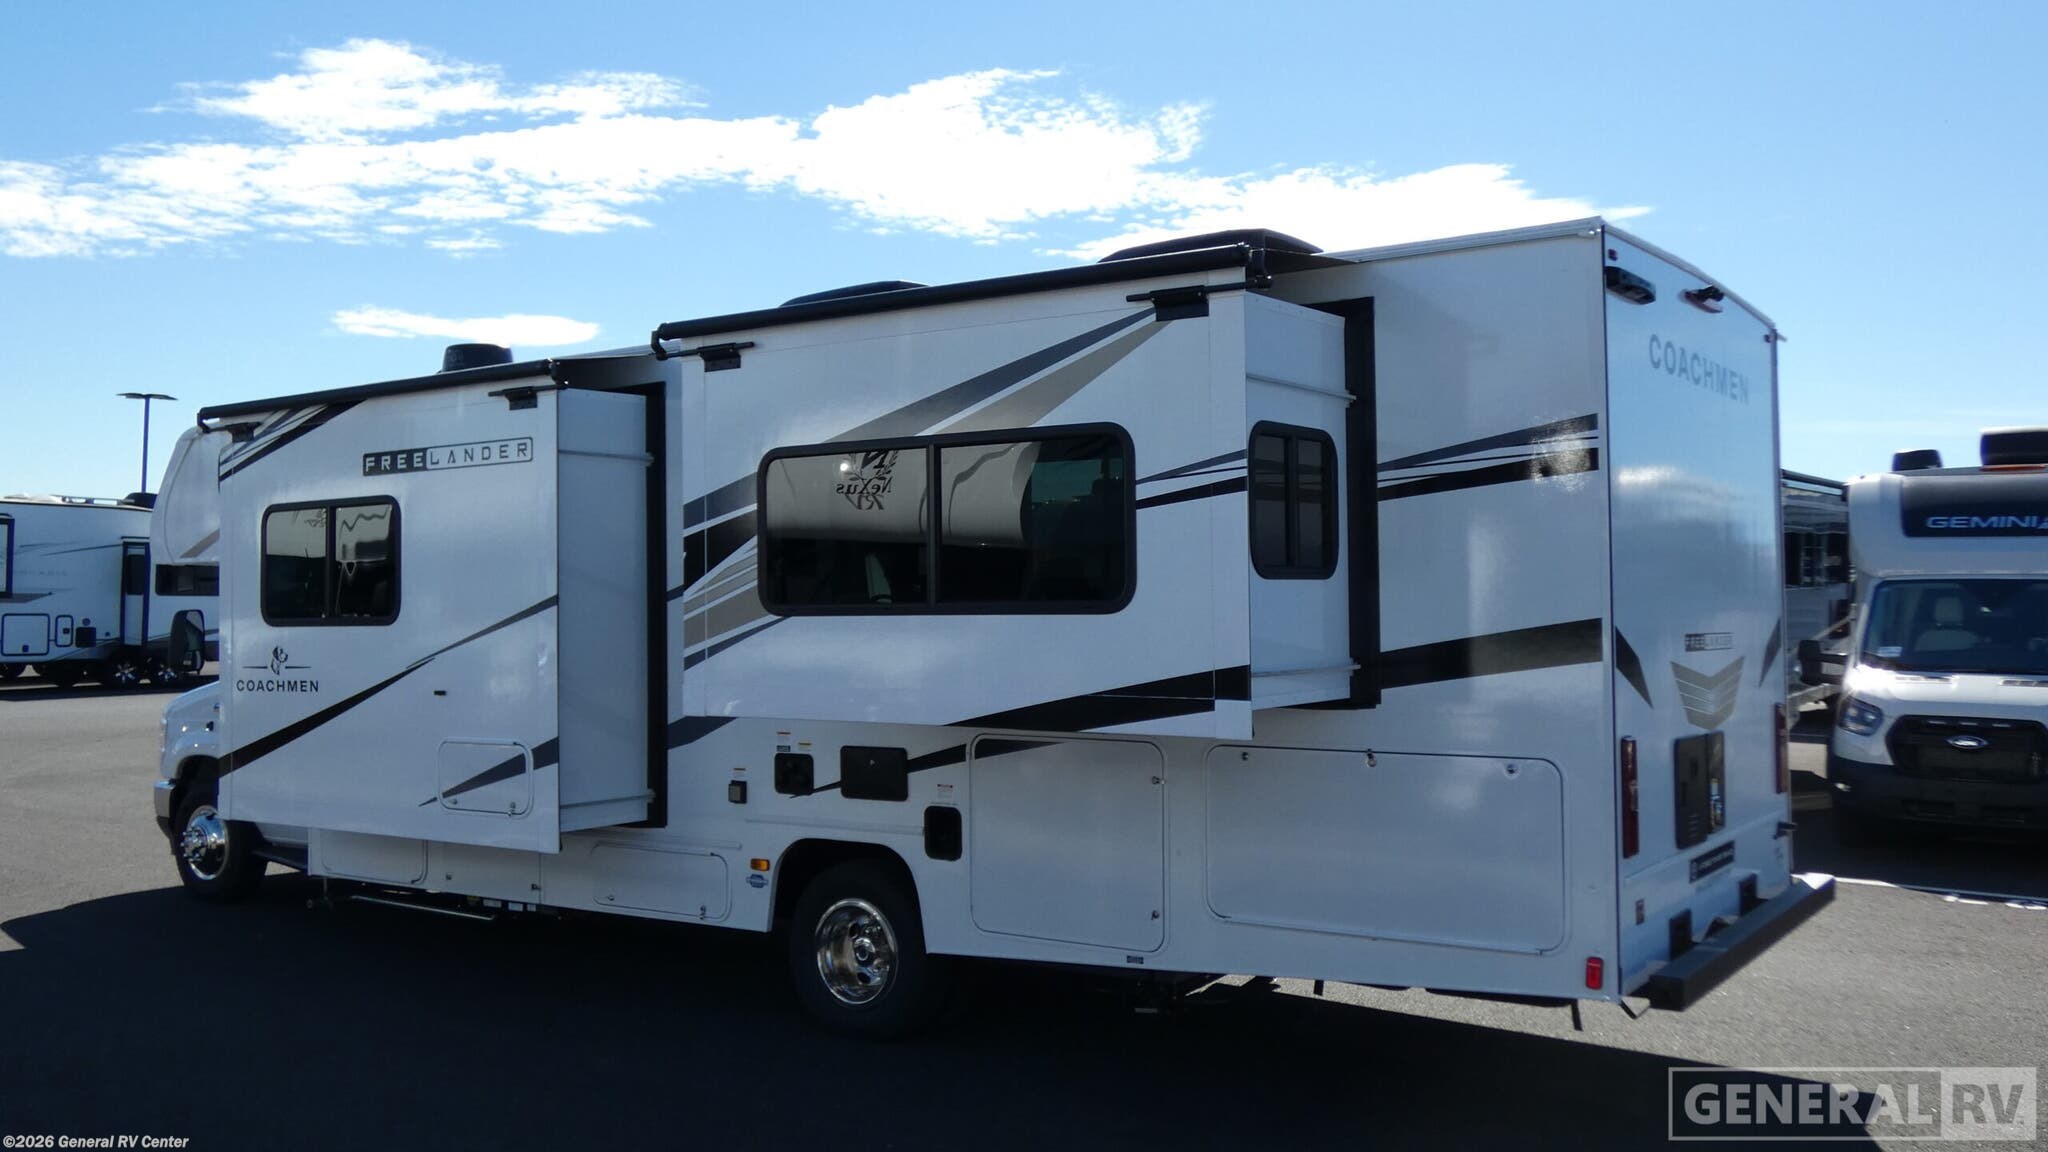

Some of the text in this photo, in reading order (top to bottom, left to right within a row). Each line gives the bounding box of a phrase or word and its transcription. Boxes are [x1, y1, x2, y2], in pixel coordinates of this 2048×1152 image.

[1648, 333, 1750, 405] COACHMEN
[365, 442, 528, 473] FREELANDER
[1926, 515, 2038, 529] GEMINI
[236, 679, 320, 693] COACHMEN
